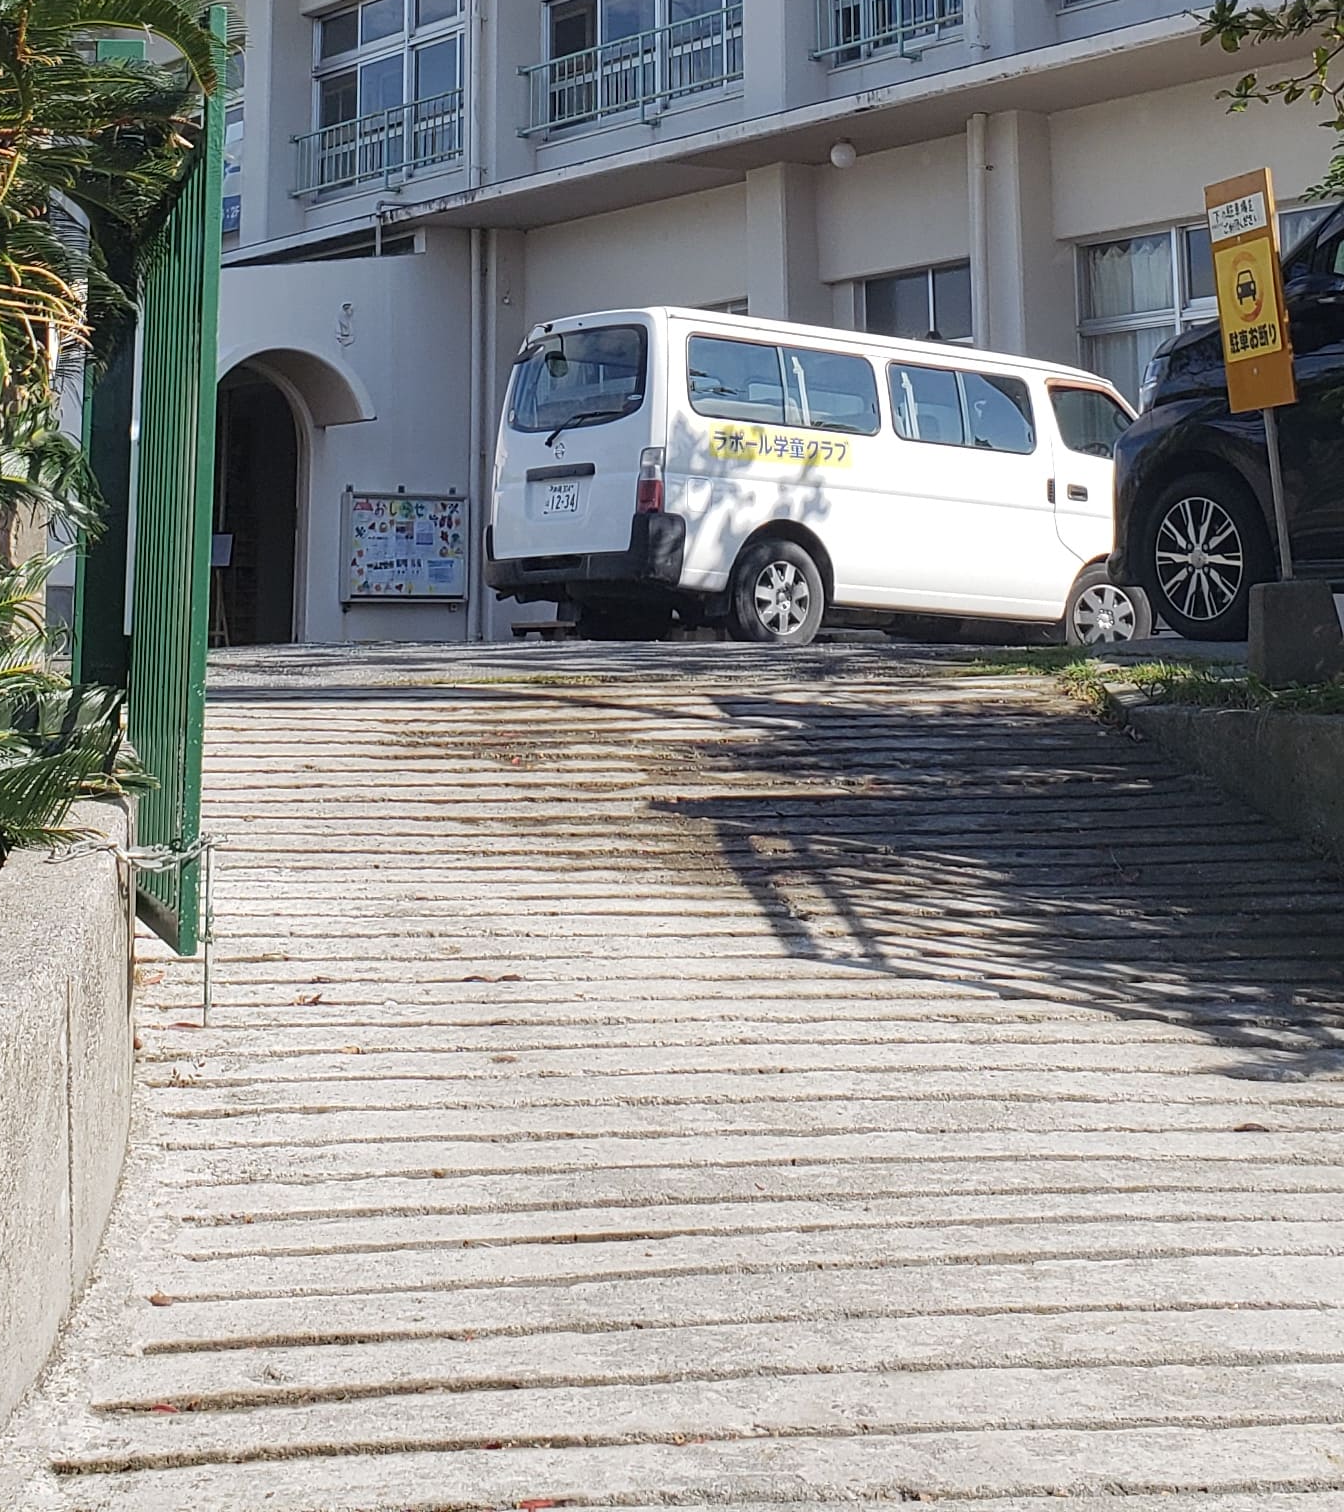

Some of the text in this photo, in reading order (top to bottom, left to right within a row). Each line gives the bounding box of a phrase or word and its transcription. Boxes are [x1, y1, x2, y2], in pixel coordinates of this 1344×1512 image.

[1229, 323, 1277, 354] 駐車お断り
[713, 430, 849, 462] ラポール学童クラブ
